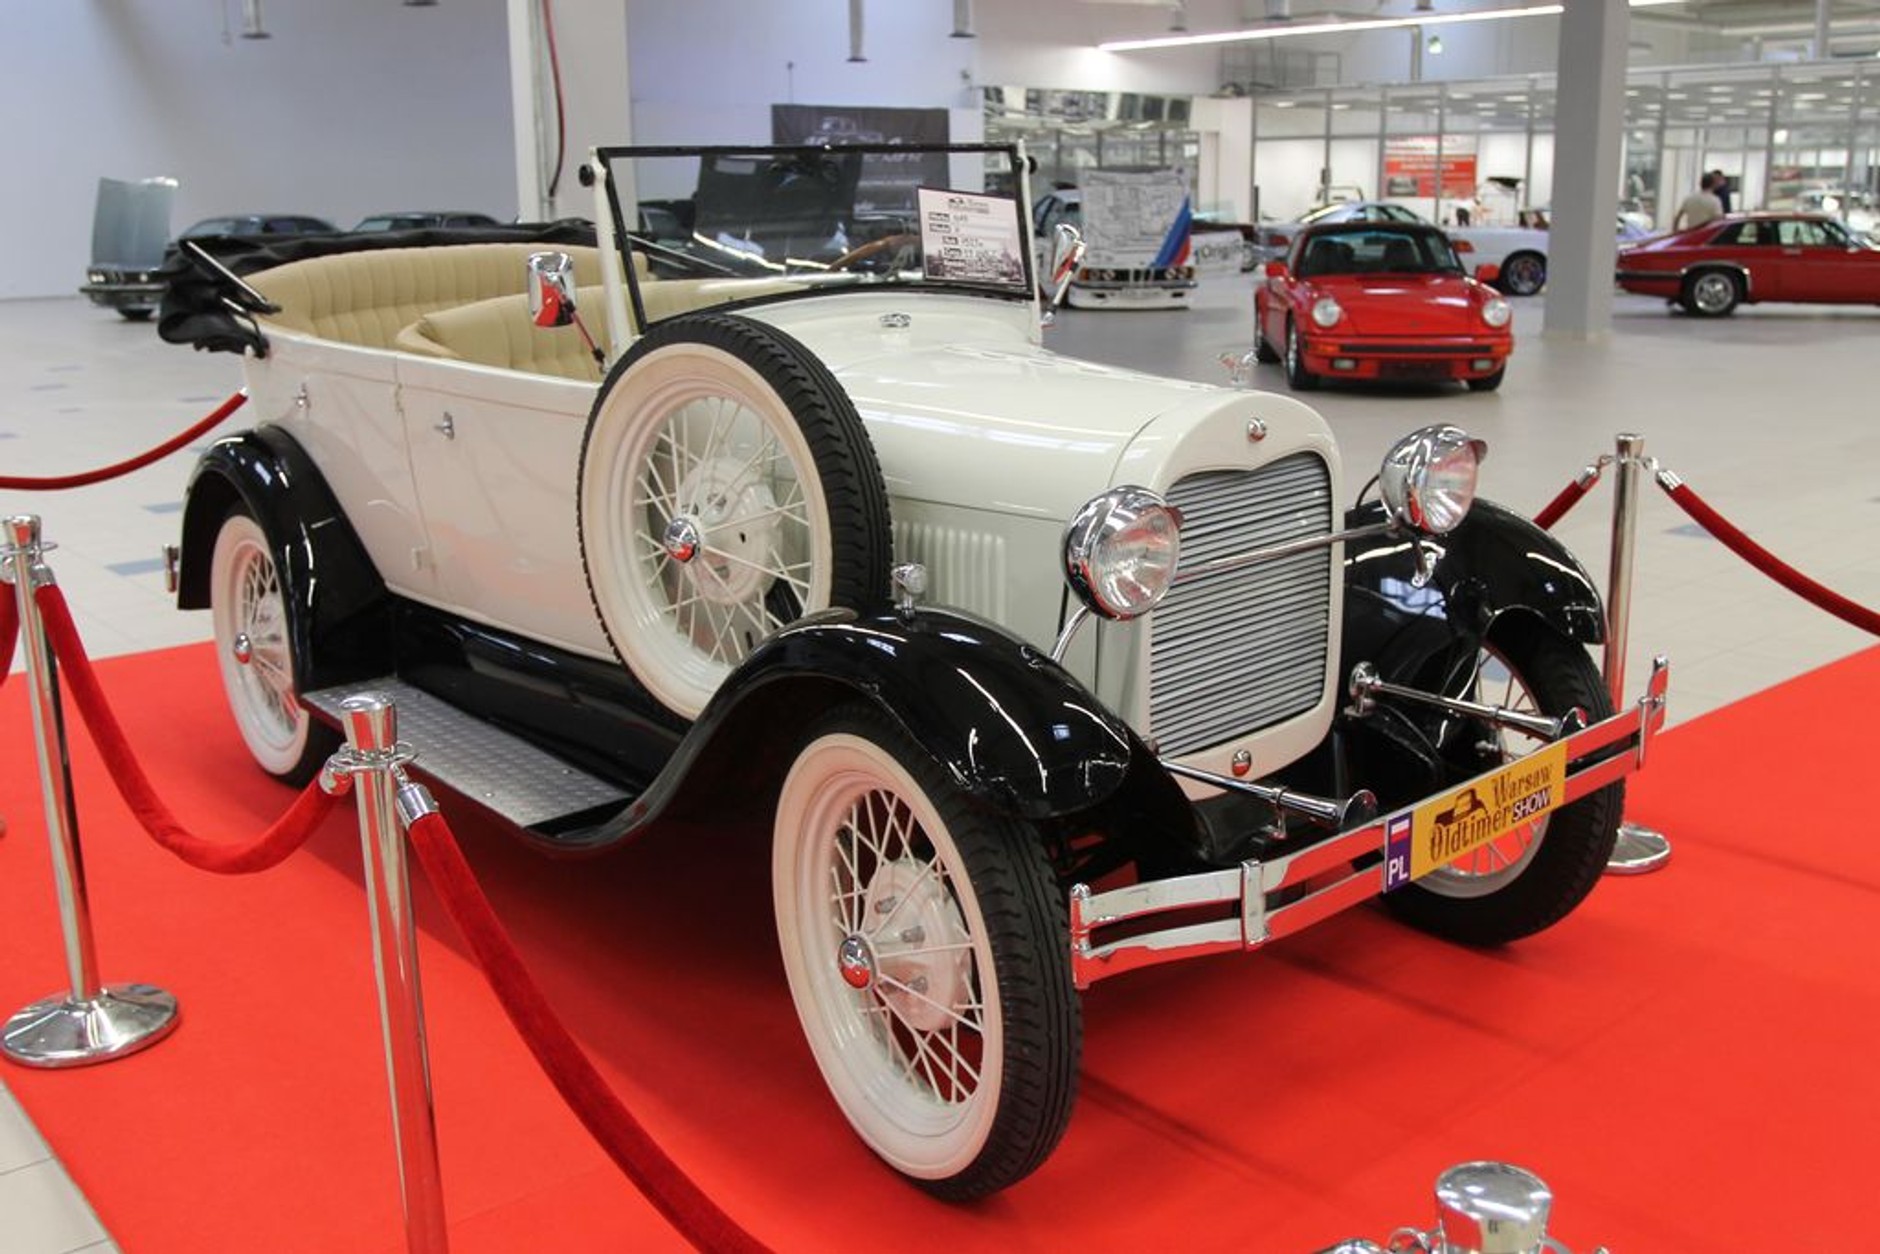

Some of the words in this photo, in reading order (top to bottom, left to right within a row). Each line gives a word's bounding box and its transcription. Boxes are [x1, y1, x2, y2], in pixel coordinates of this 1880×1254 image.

[1492, 764, 1550, 805] Warsaw
[1430, 806, 1512, 861] Oldtimer
[1512, 788, 1550, 822] SHOW
[1388, 856, 1409, 886] PL
